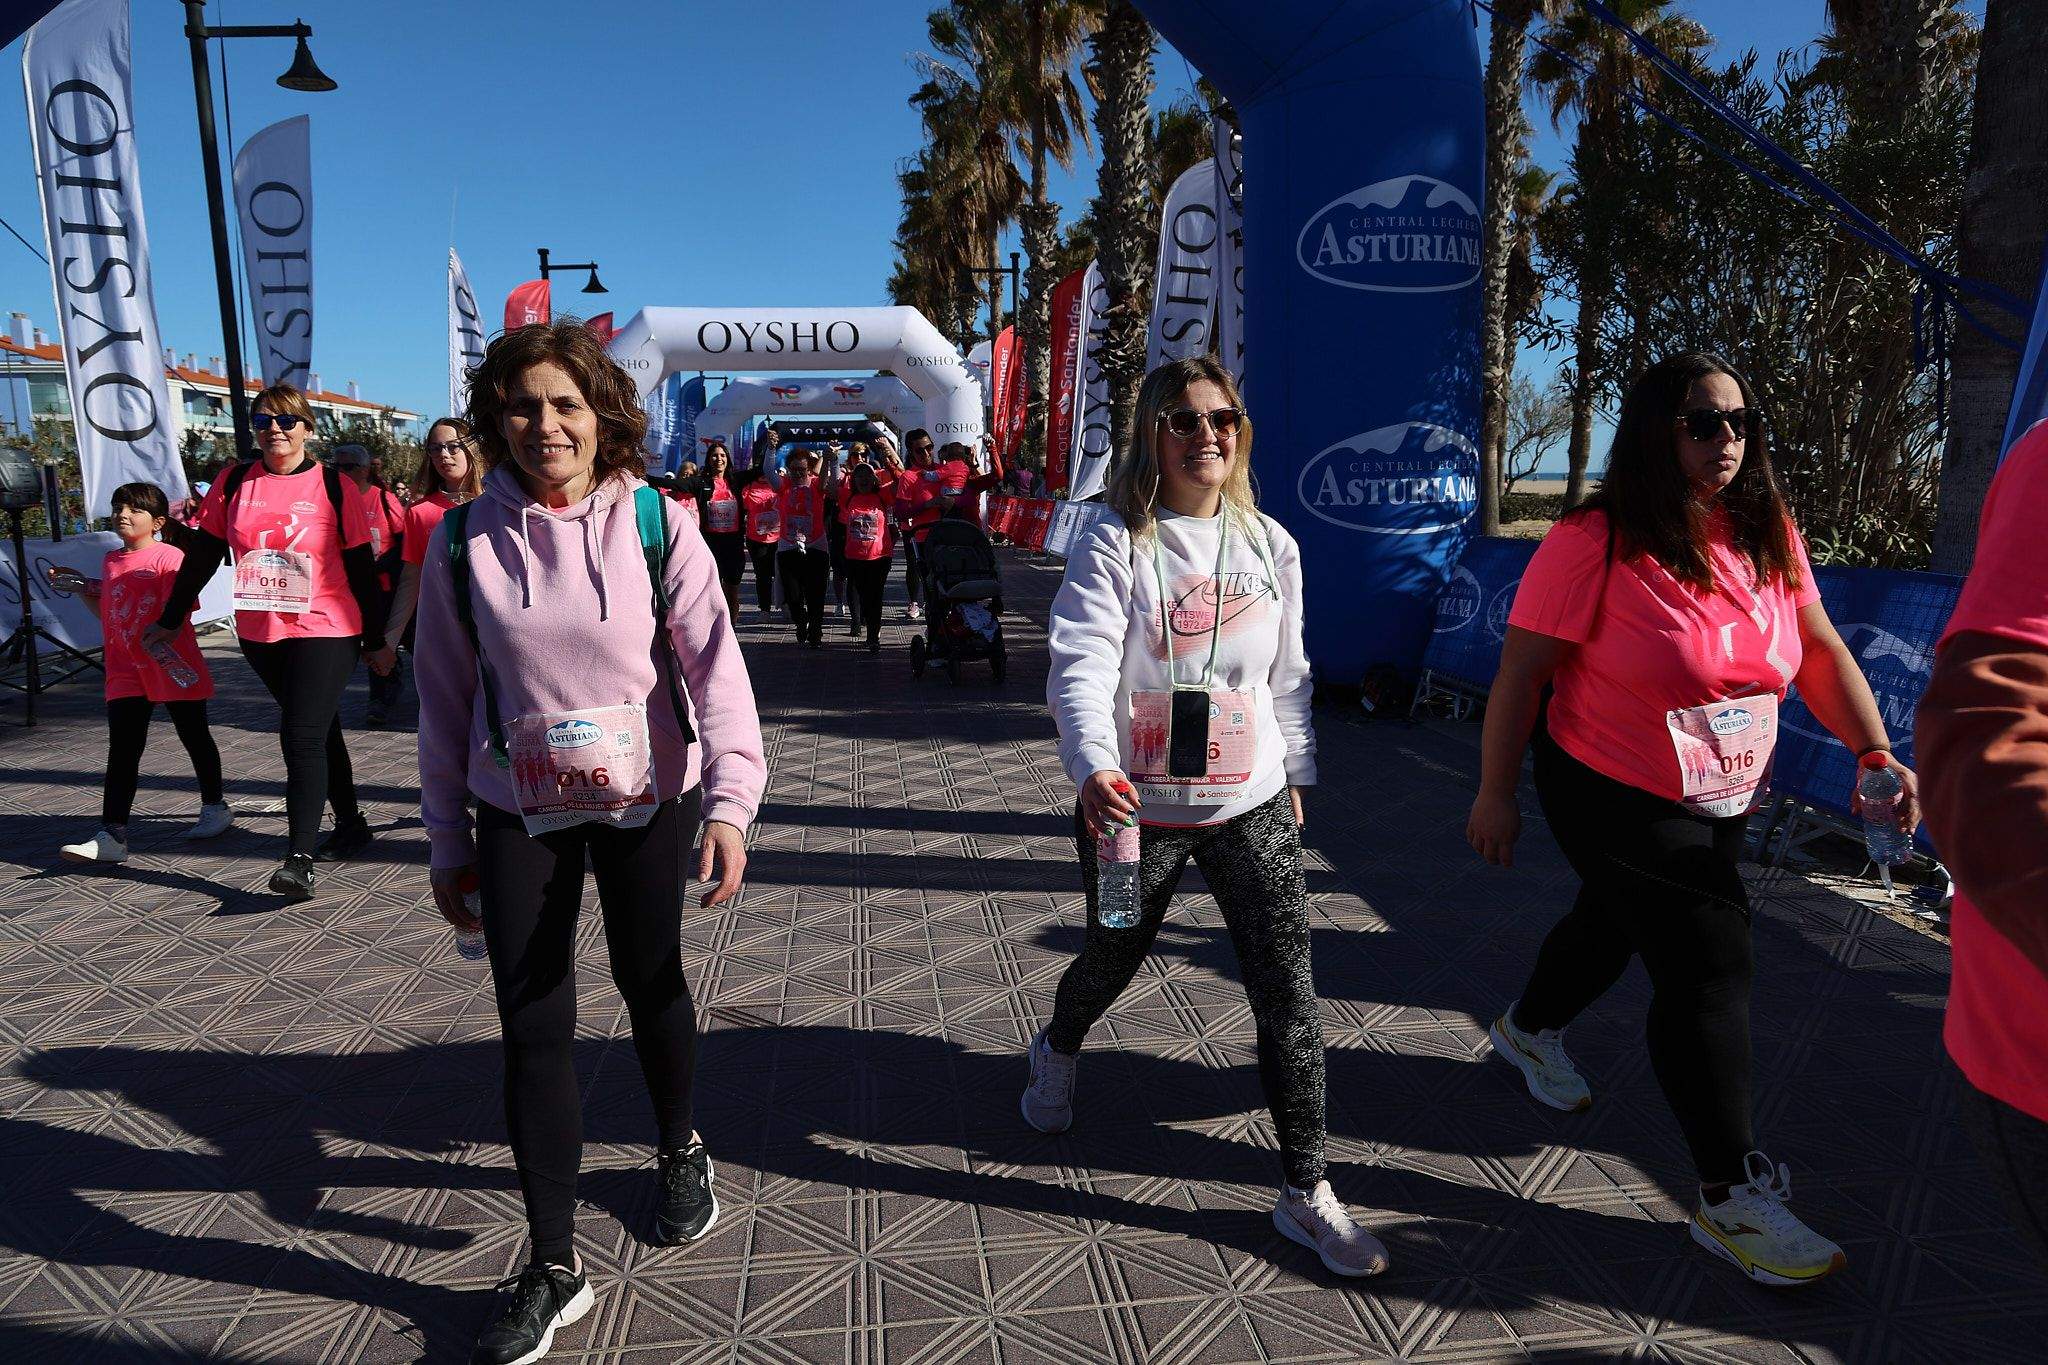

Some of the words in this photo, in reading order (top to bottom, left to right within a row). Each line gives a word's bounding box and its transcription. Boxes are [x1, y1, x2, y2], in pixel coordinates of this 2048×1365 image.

[1350, 216, 1425, 229] CENTRAL
[46, 79, 157, 442] OYSHO
[249, 181, 312, 387] YSHO
[1160, 203, 1216, 357] SHO
[697, 320, 860, 354] OYSHO
[1060, 296, 1082, 390] Santander
[618, 359, 650, 370] SHO
[906, 355, 954, 367] OYSHO
[934, 422, 979, 434] OYSHO
[1349, 460, 1424, 473] CENTRAL
[260, 577, 287, 588] 016
[1178, 620, 1199, 630] 1972
[1720, 749, 1754, 775] 016
[557, 767, 610, 788] 016
[1141, 788, 1182, 799] OYSHO
